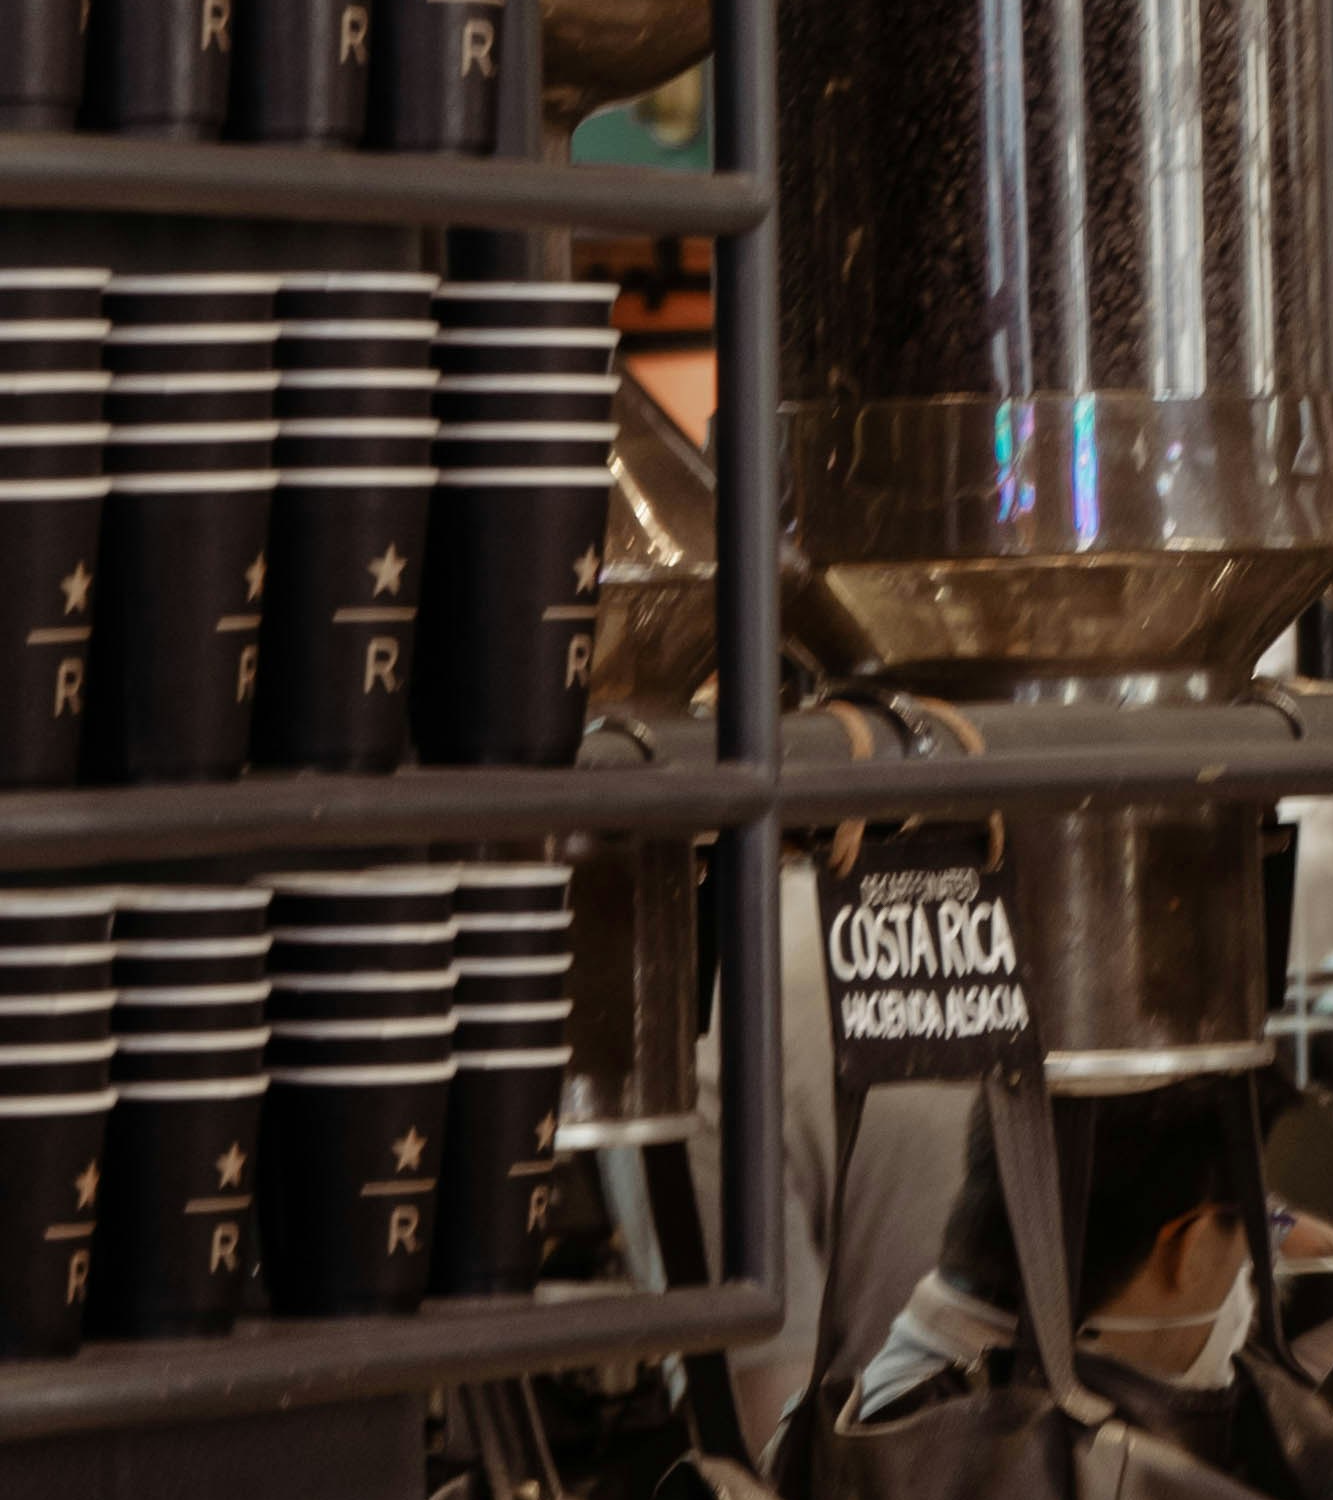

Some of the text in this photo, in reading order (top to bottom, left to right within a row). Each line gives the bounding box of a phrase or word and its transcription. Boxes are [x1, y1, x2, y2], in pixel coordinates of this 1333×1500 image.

[339, 5, 368, 65] R
[459, 18, 494, 79] R
[54, 657, 84, 719] R
[363, 635, 398, 695] R
[564, 632, 591, 690] R
[829, 896, 1016, 982] COSTA RICA
[210, 1222, 240, 1274] R
[387, 1204, 418, 1256] R
